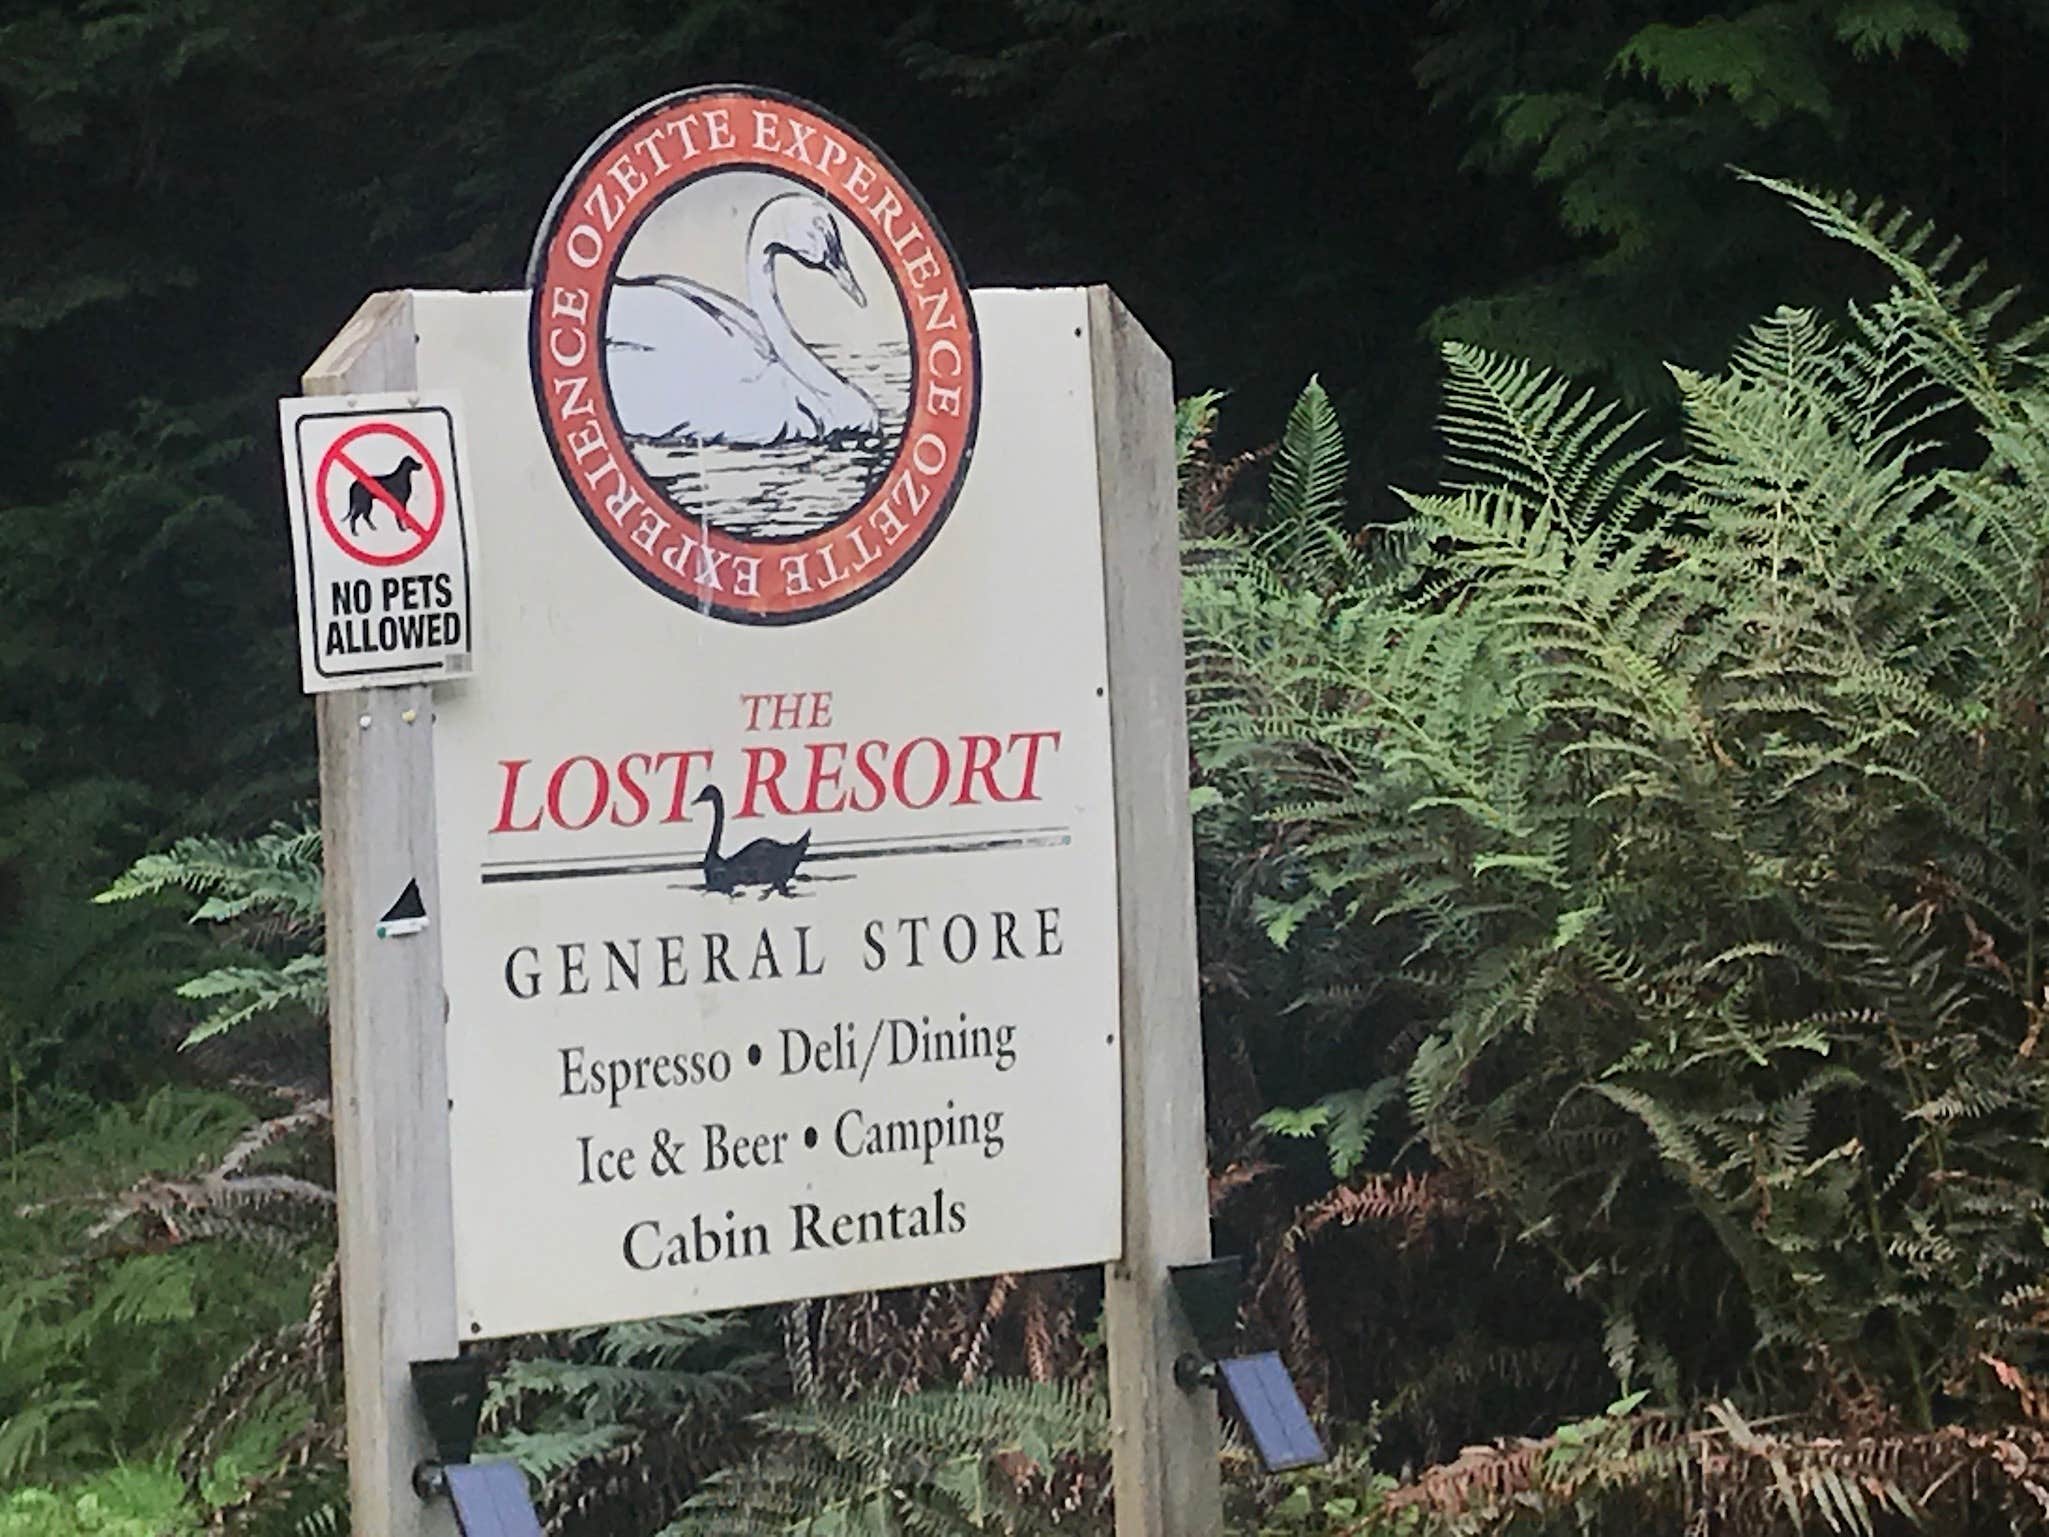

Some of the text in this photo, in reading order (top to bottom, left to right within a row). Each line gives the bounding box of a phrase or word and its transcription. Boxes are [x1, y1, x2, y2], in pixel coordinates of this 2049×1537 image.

[567, 108, 963, 417] OZETTE EXPERIENCE
[550, 287, 760, 597] EXPERIENCE
[781, 432, 948, 597] OZETTE
[326, 612, 462, 656] ALLOWED
[332, 573, 452, 616] NO PETS
[740, 691, 833, 731] THE
[489, 731, 1061, 834] LOST RESORT
[505, 907, 1064, 999] GENERAL STORE
[558, 1013, 1017, 1108] Espresso Deli/Dining
[577, 1101, 1004, 1185] Ice & Beer Camping
[622, 1188, 966, 1271] Cabin Rentals
